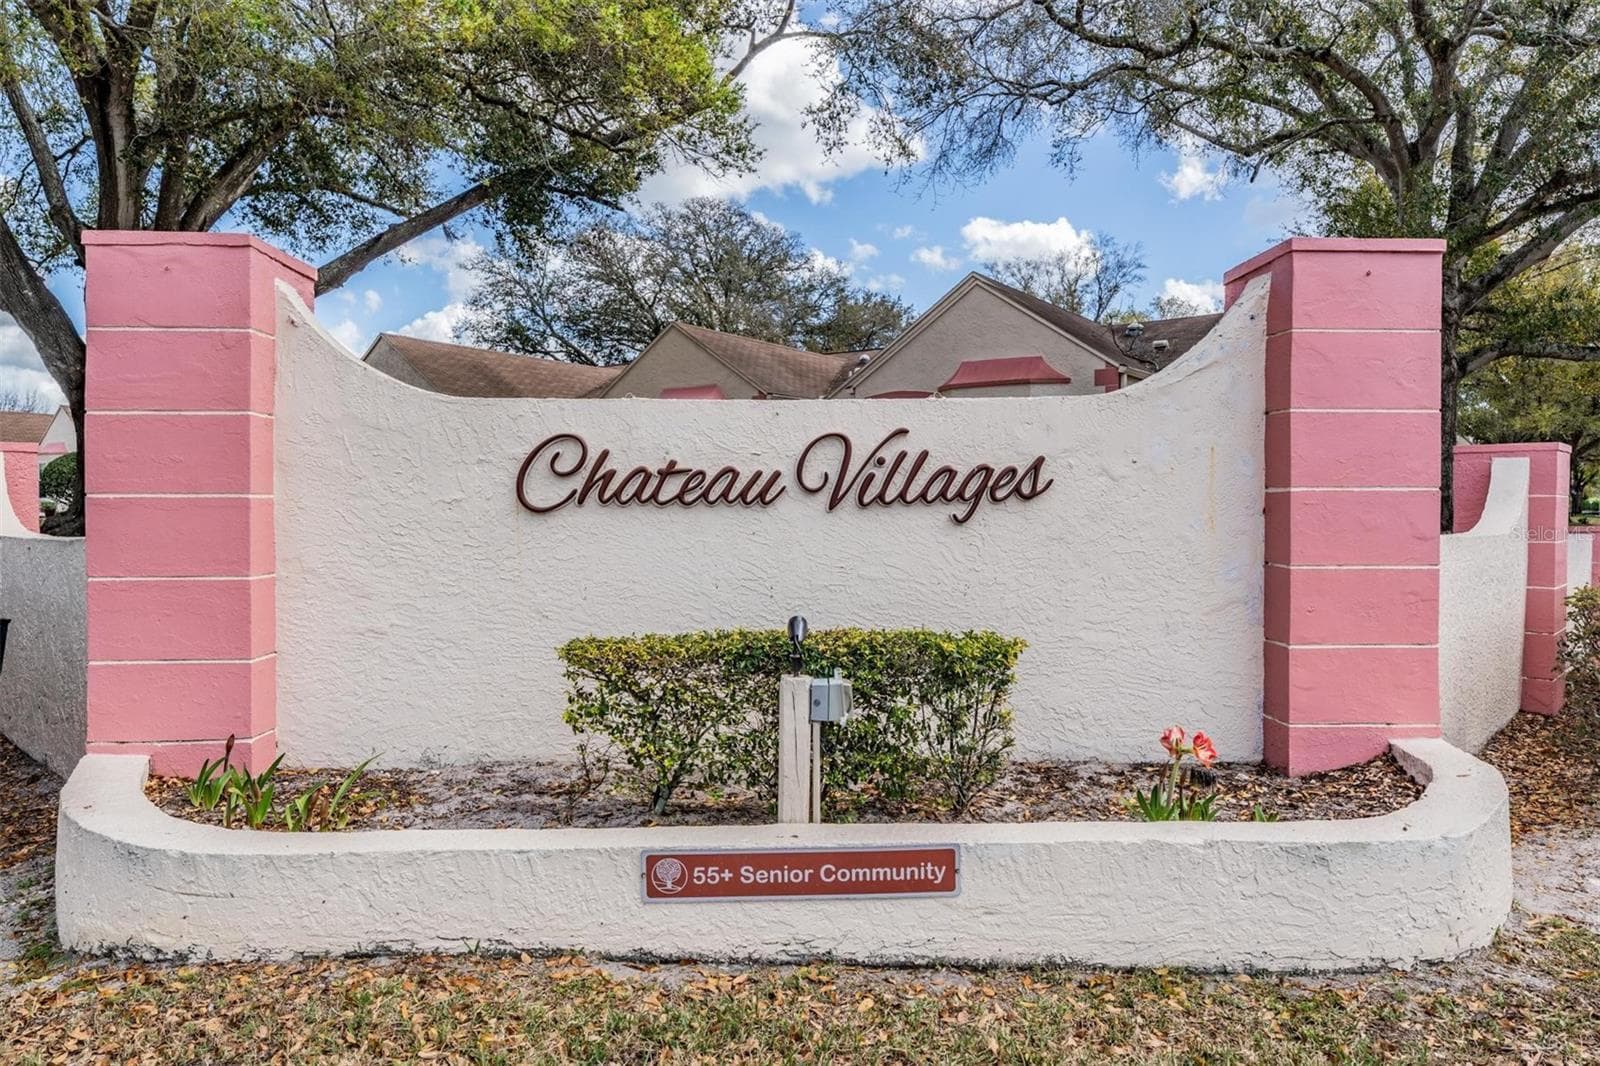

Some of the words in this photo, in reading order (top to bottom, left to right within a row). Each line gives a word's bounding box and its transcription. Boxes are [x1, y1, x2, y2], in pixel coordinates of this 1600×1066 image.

[515, 432, 787, 514] Chateau
[796, 428, 1054, 525] Villages
[692, 866, 734, 885] 55+
[739, 865, 814, 884] Senior
[819, 861, 947, 884] Community
